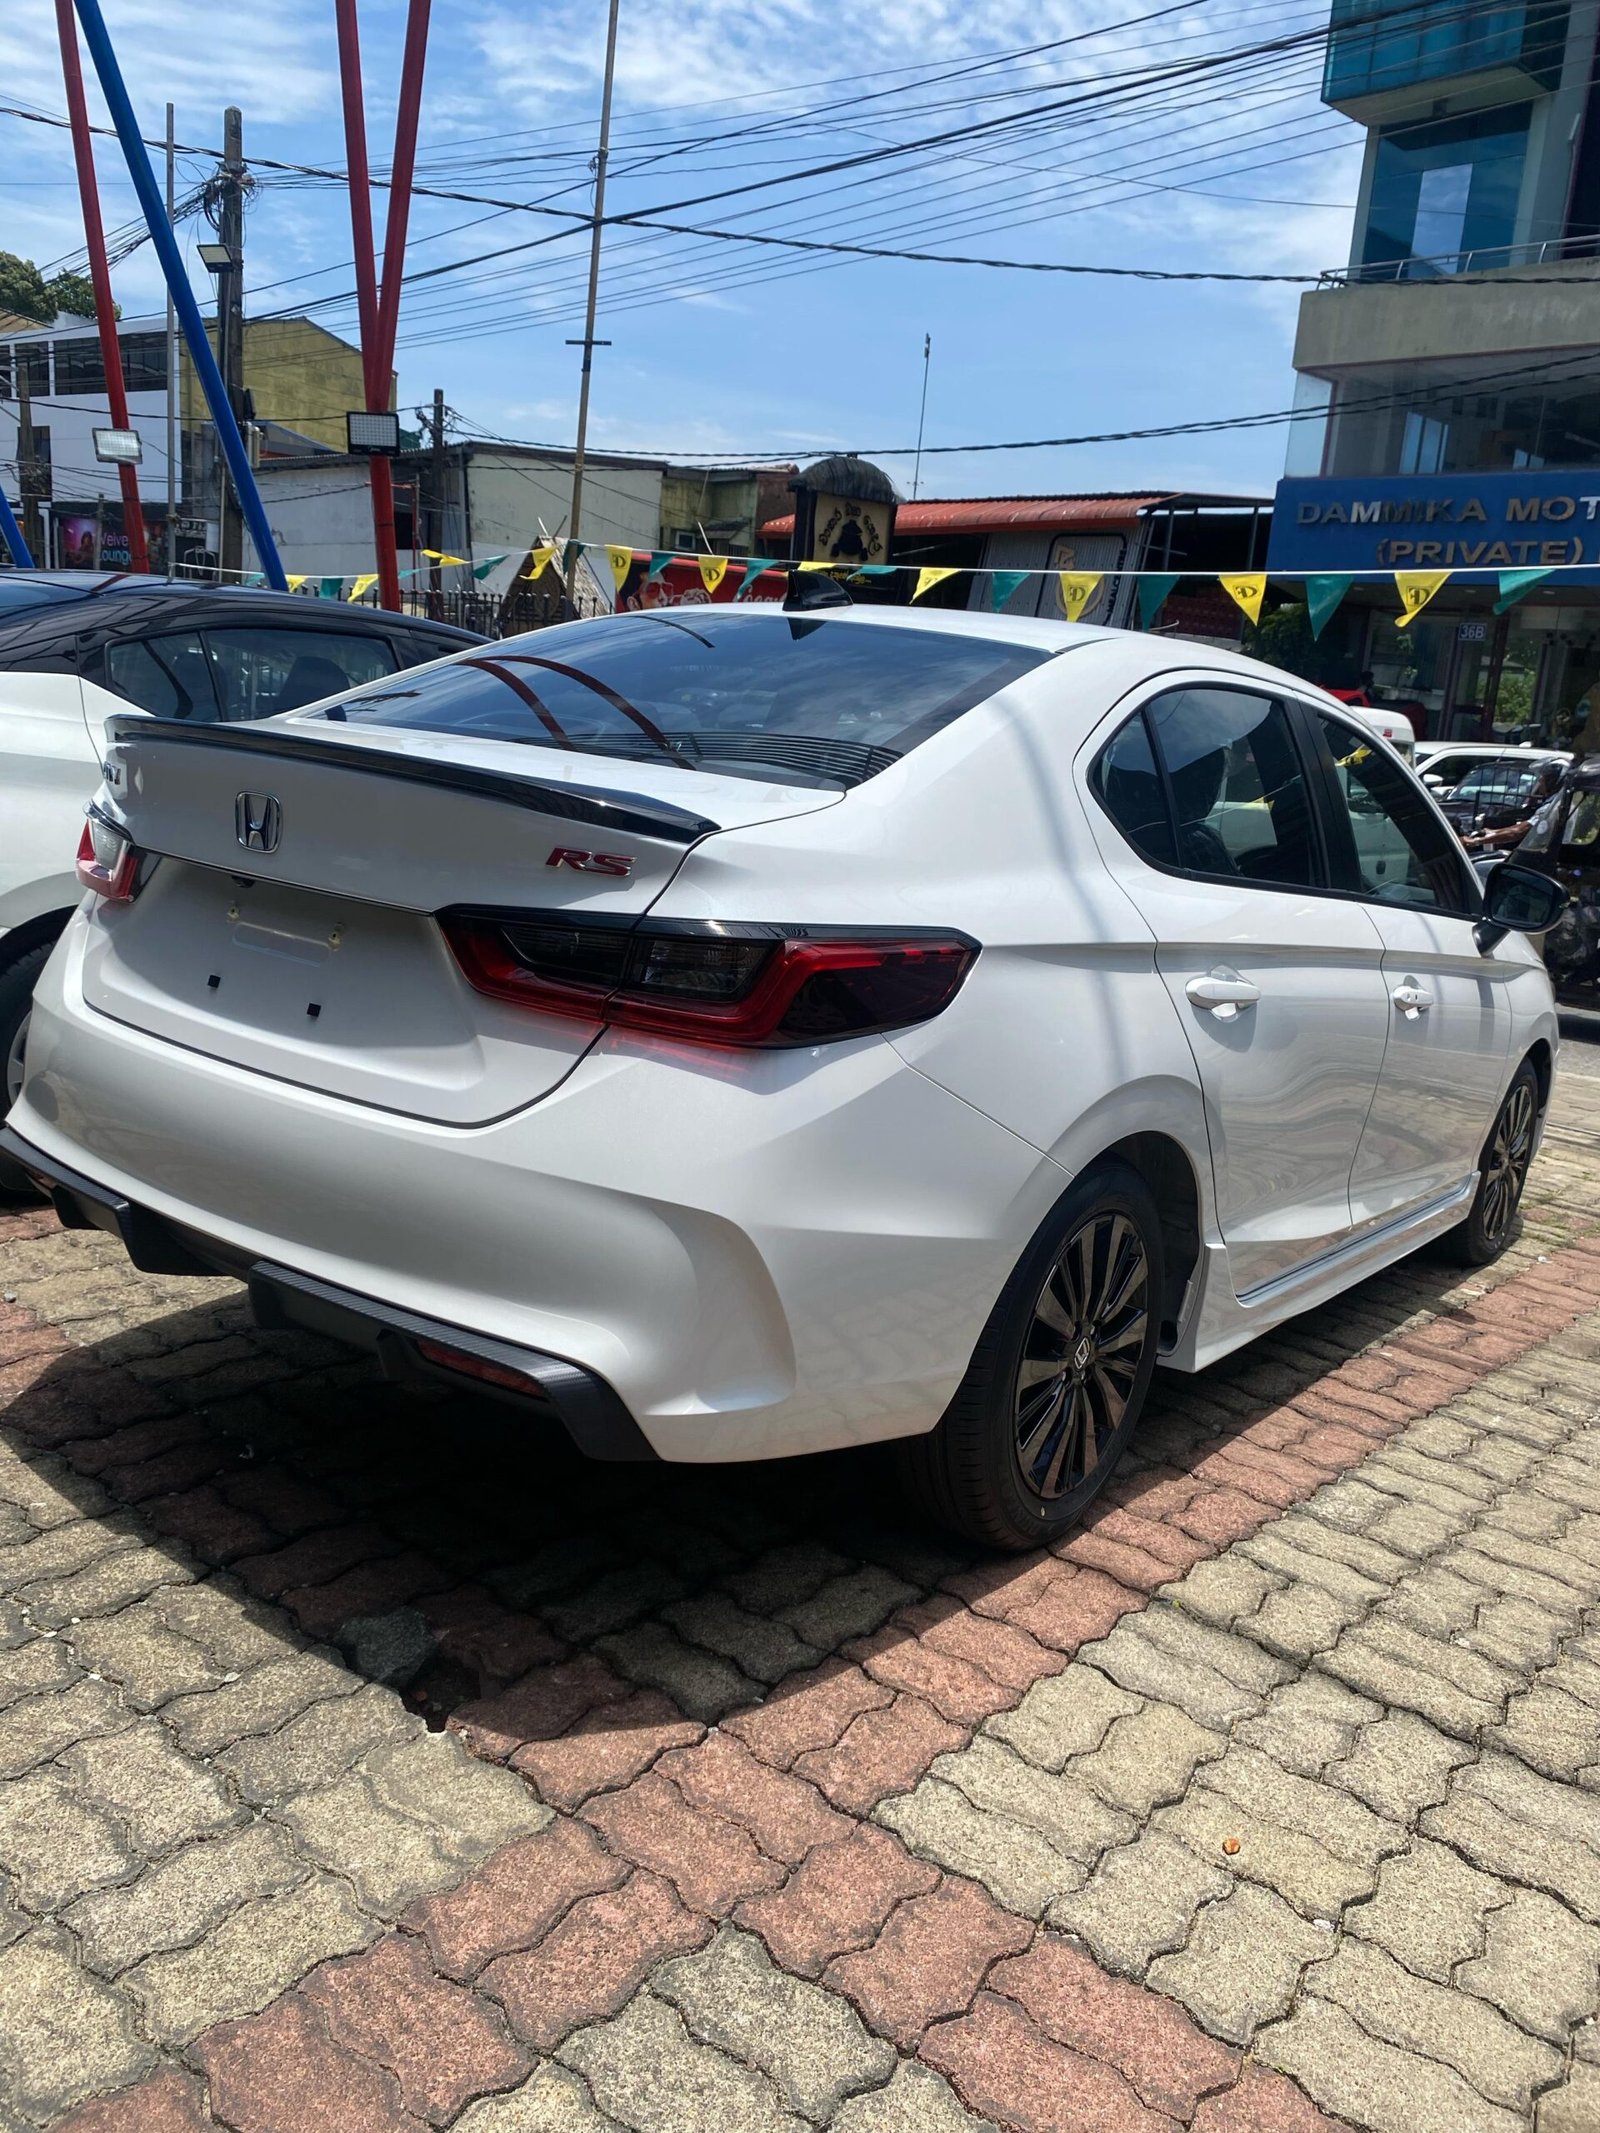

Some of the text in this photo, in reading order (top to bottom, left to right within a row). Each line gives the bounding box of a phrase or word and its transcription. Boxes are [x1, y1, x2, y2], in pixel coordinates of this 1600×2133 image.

[1296, 498, 1487, 524] DAMMIKA
[1376, 537, 1584, 566] (PRIVATE)
[1460, 625, 1485, 639] 36B
[545, 846, 638, 877] RS
